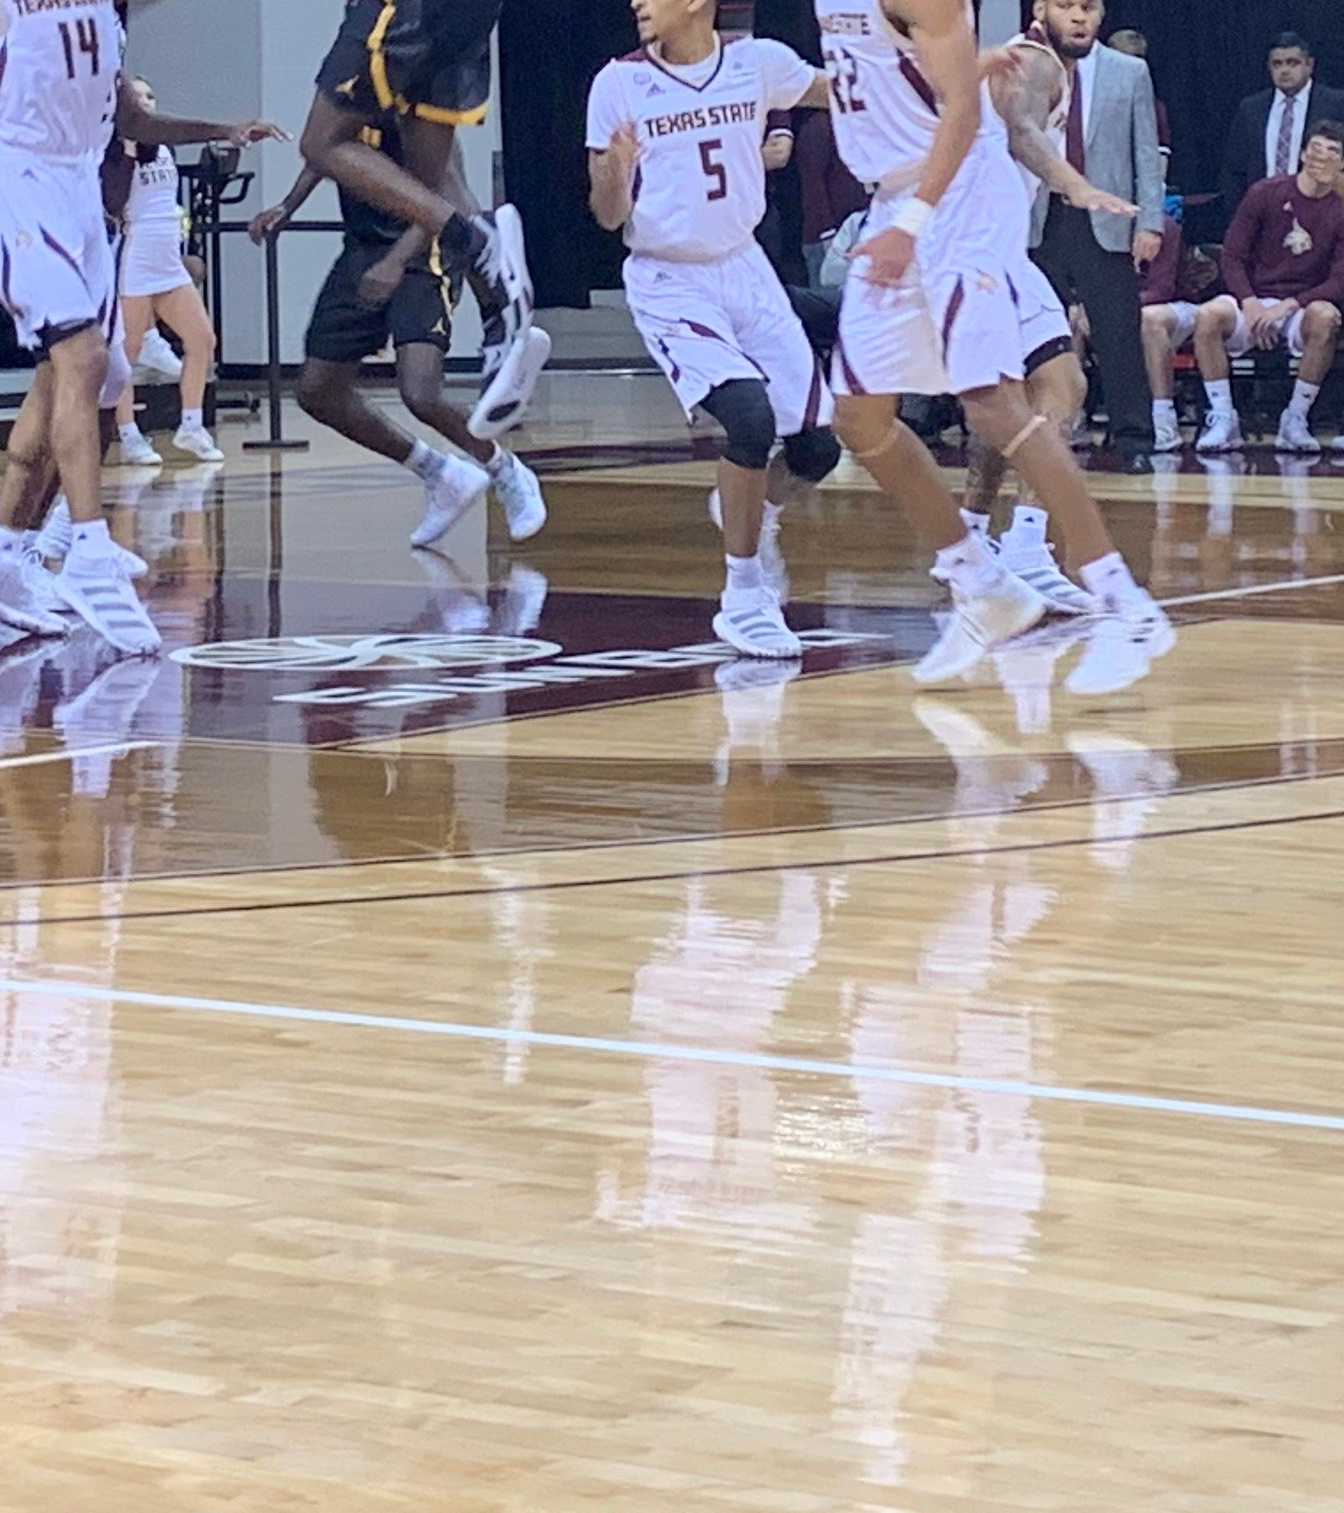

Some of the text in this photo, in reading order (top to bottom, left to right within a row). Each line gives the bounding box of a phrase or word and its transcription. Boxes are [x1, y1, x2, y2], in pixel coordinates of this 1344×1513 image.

[58, 18, 99, 79] 14
[645, 100, 758, 138] TEXAS STATE
[698, 139, 727, 201] 5
